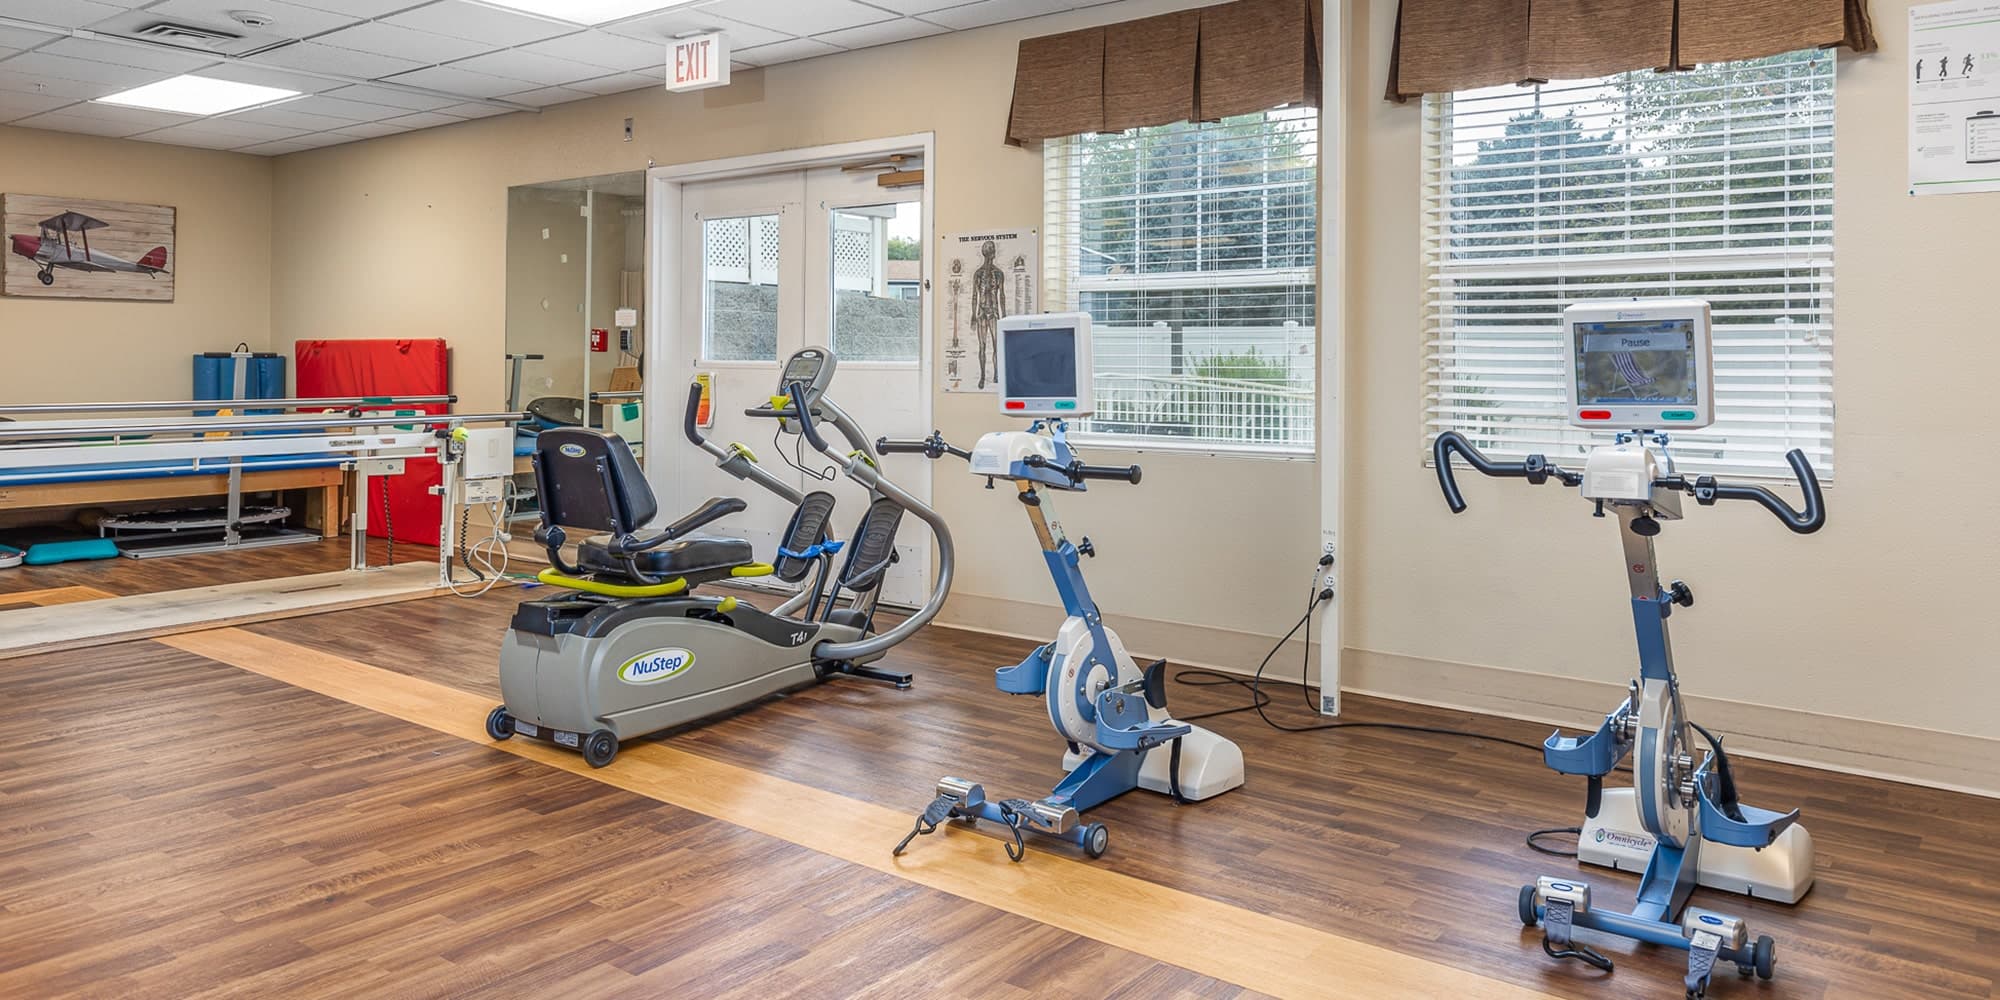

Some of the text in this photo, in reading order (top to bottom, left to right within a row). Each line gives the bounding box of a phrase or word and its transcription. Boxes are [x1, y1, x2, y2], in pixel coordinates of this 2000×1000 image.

[676, 40, 710, 83] EXIT
[1621, 338, 1650, 347] Pause
[633, 656, 682, 676] NuStep
